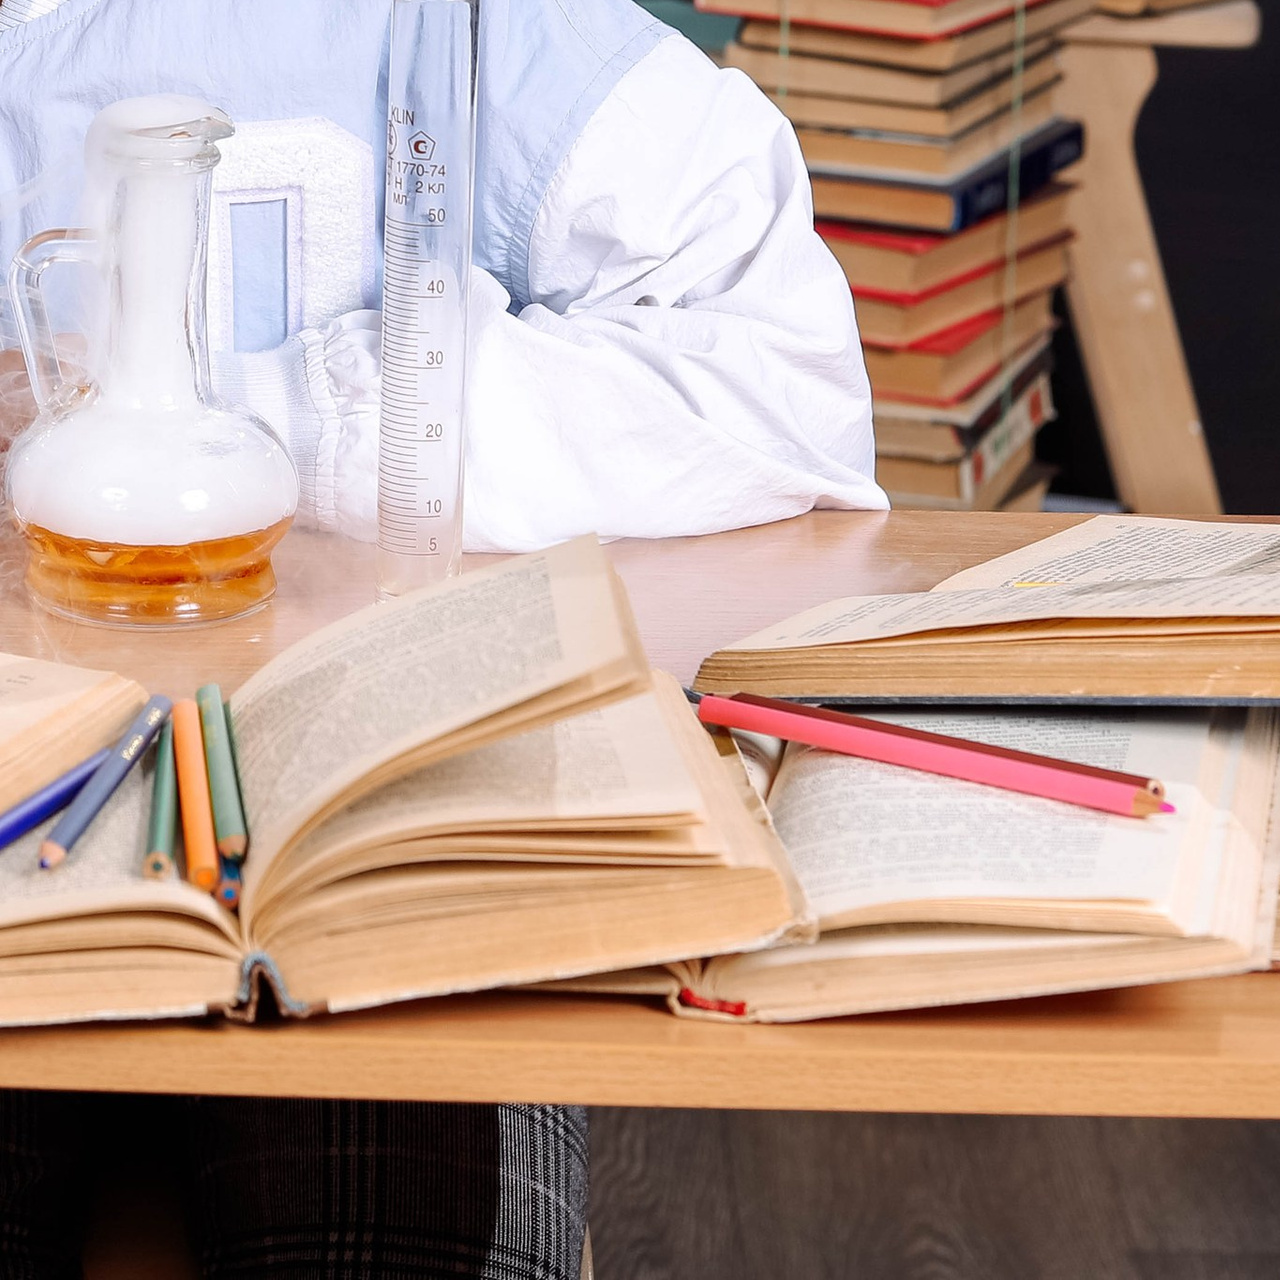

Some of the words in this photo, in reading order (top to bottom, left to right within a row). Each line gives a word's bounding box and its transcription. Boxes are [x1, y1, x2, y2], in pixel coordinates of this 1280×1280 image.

[397, 161, 446, 177] 1770-74
[415, 180, 424, 194] 2
[428, 208, 446, 223] 50
[426, 279, 445, 294] 40
[426, 350, 444, 366] 30
[425, 423, 443, 438] 20
[426, 499, 442, 514] 10
[428, 537, 438, 552] 5
